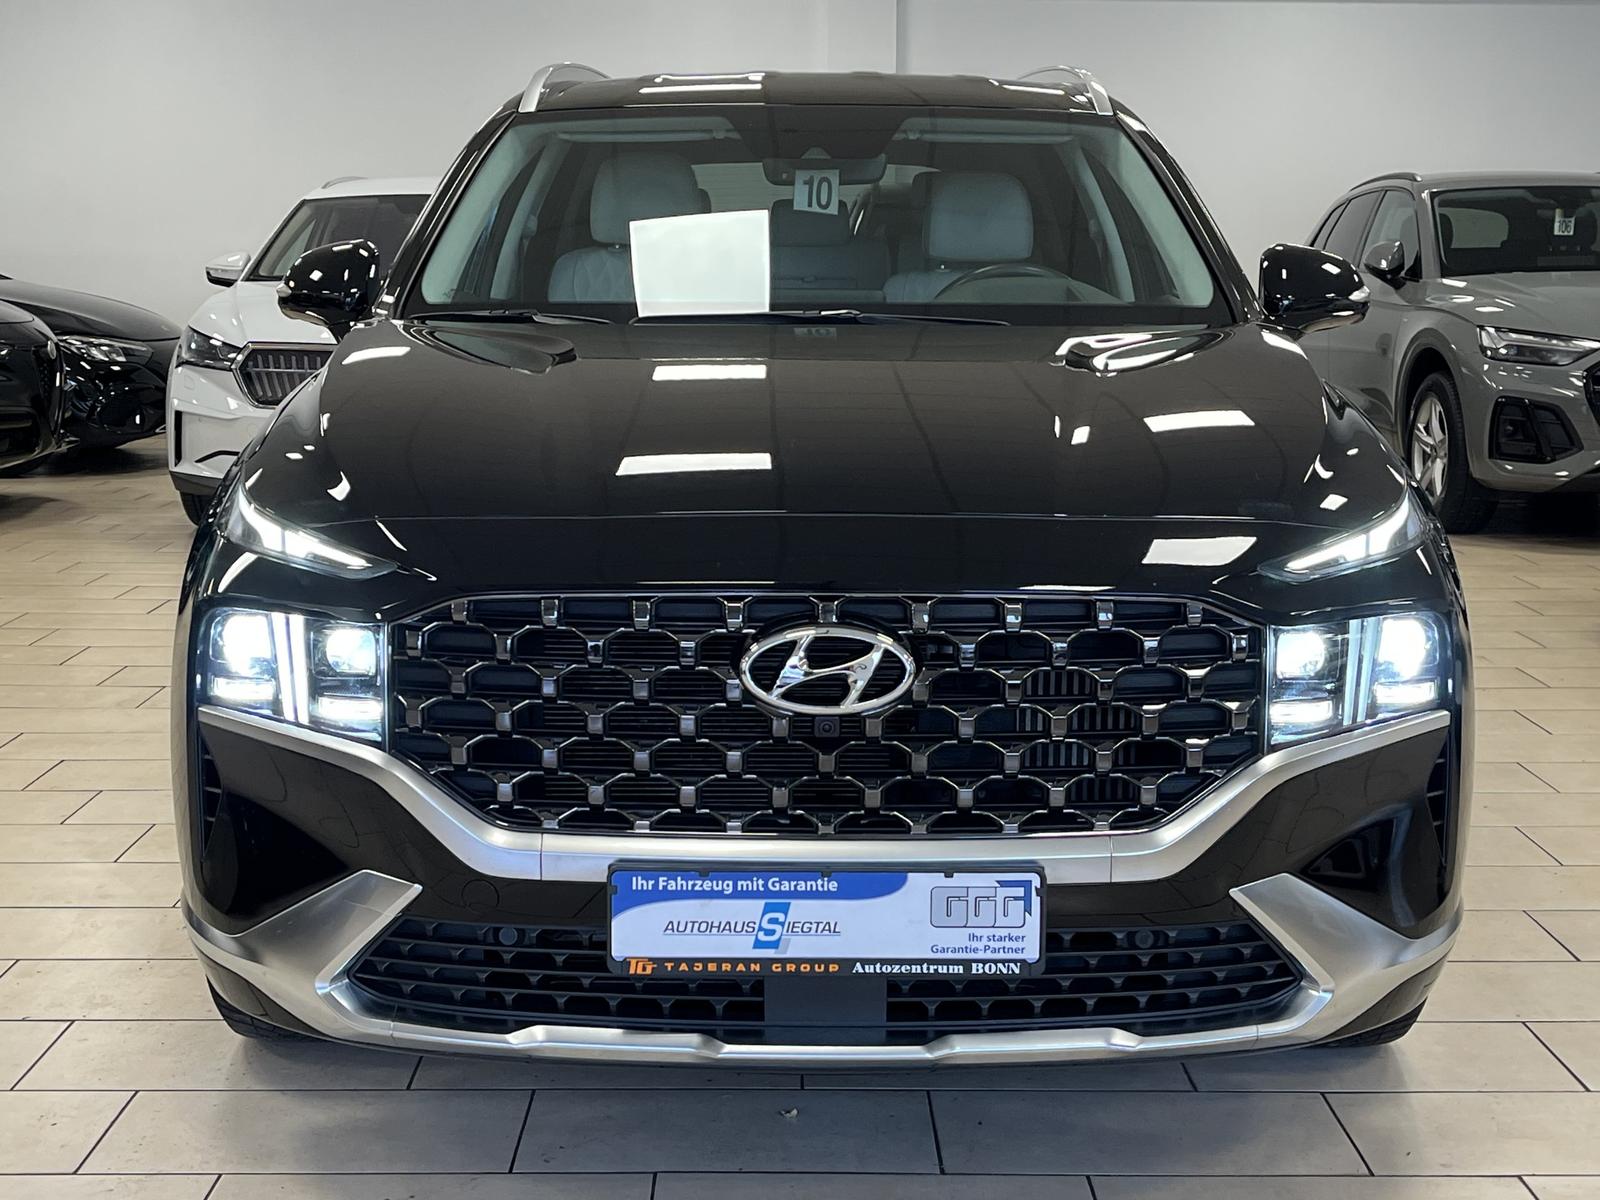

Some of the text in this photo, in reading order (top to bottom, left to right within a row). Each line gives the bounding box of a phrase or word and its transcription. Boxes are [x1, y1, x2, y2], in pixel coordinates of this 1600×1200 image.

[803, 176, 832, 210] 10
[632, 876, 838, 894] Ihr Fahrzeug mit Garantie
[664, 921, 756, 934] AUTOHAUS
[968, 933, 1026, 942] Ihr starker
[930, 944, 1025, 954] Garantie-Partner
[665, 962, 840, 973] TAJERAN GROUP
[852, 962, 1021, 975] Autozentrum BONN
